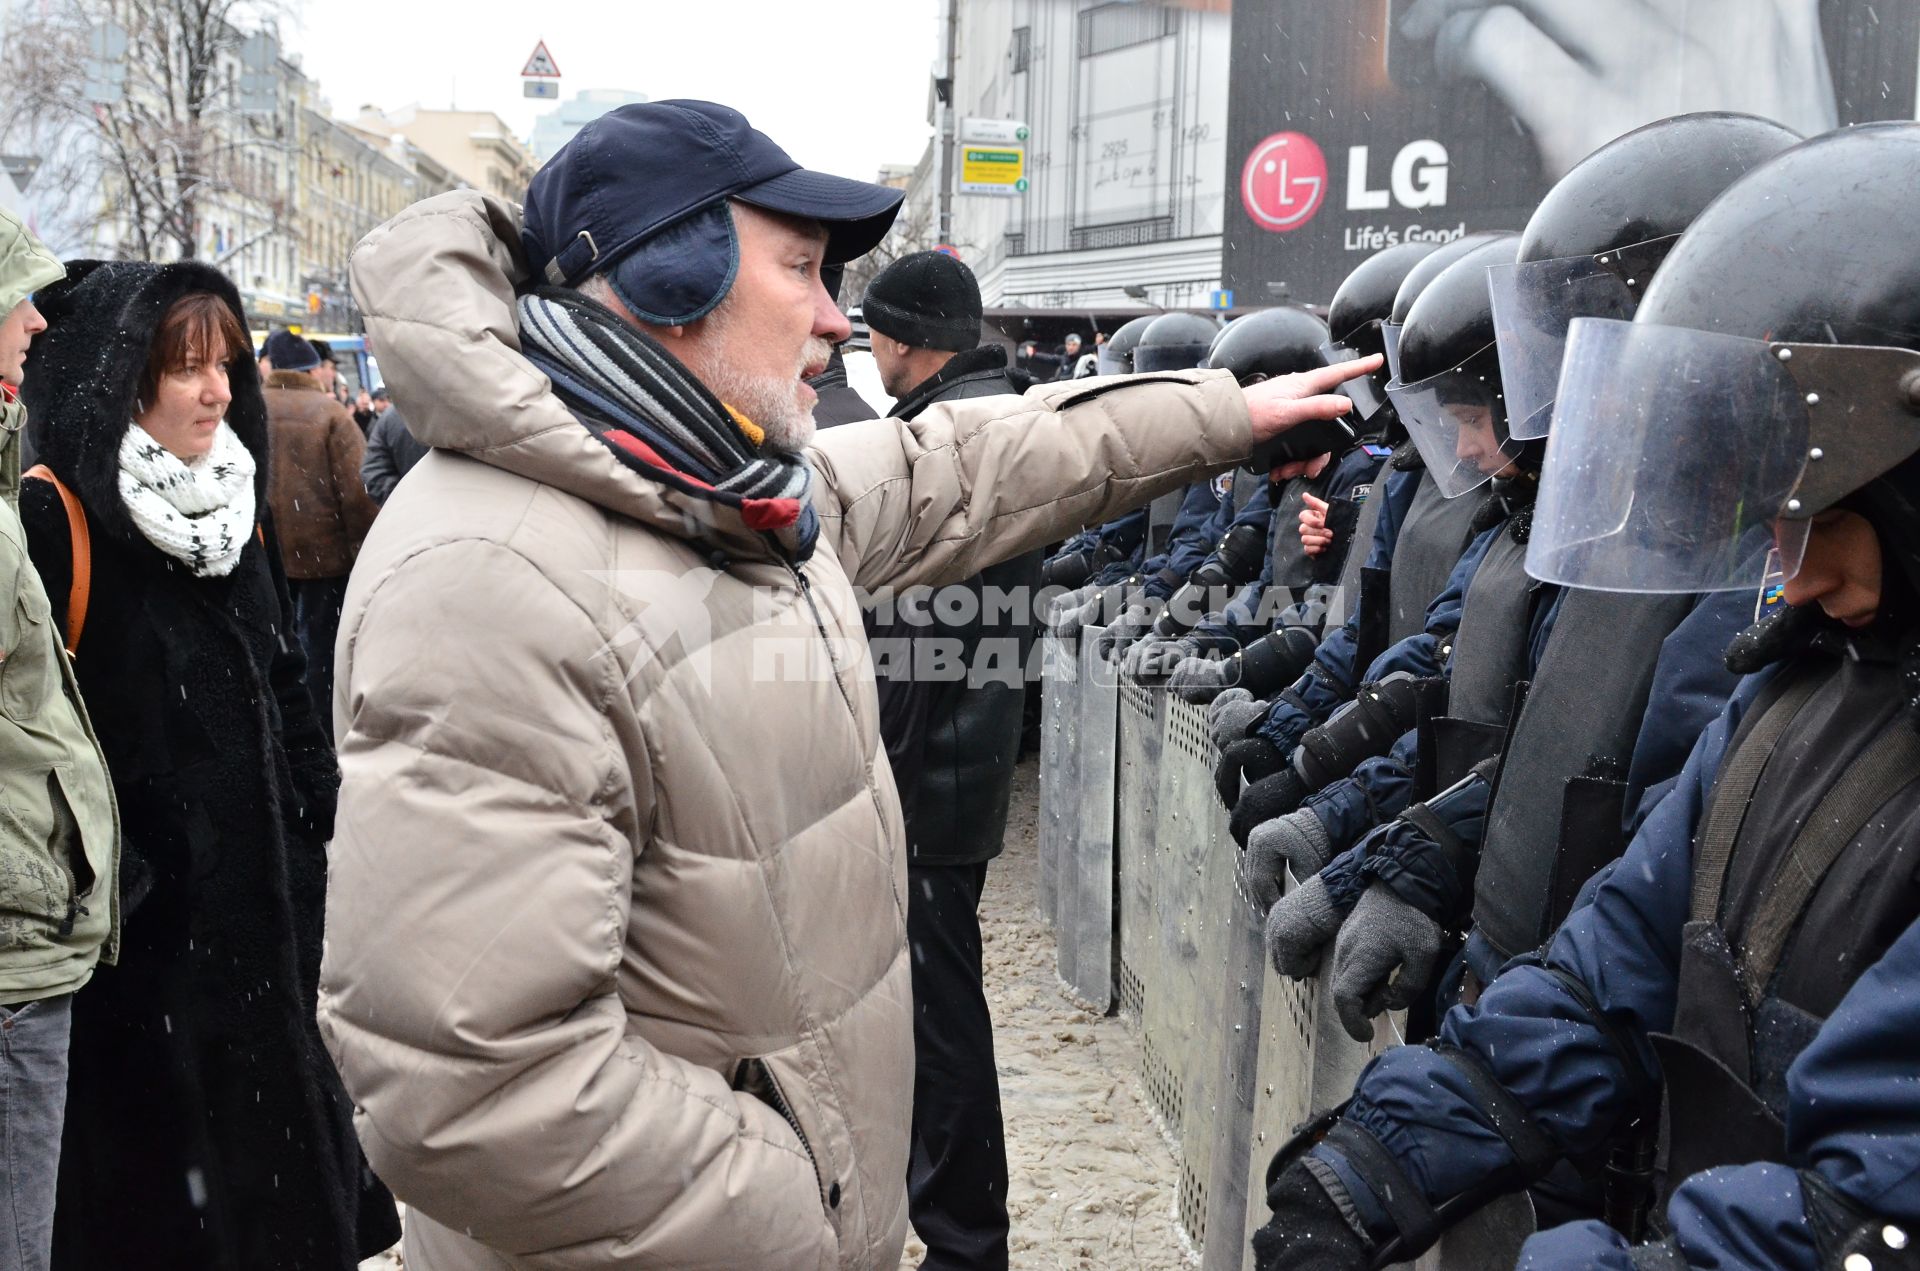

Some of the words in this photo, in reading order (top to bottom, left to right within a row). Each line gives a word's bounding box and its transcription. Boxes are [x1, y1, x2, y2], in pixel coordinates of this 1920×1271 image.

[1346, 139, 1449, 210] LG
[1344, 225, 1399, 250] Life's
[1404, 222, 1466, 244] Good
